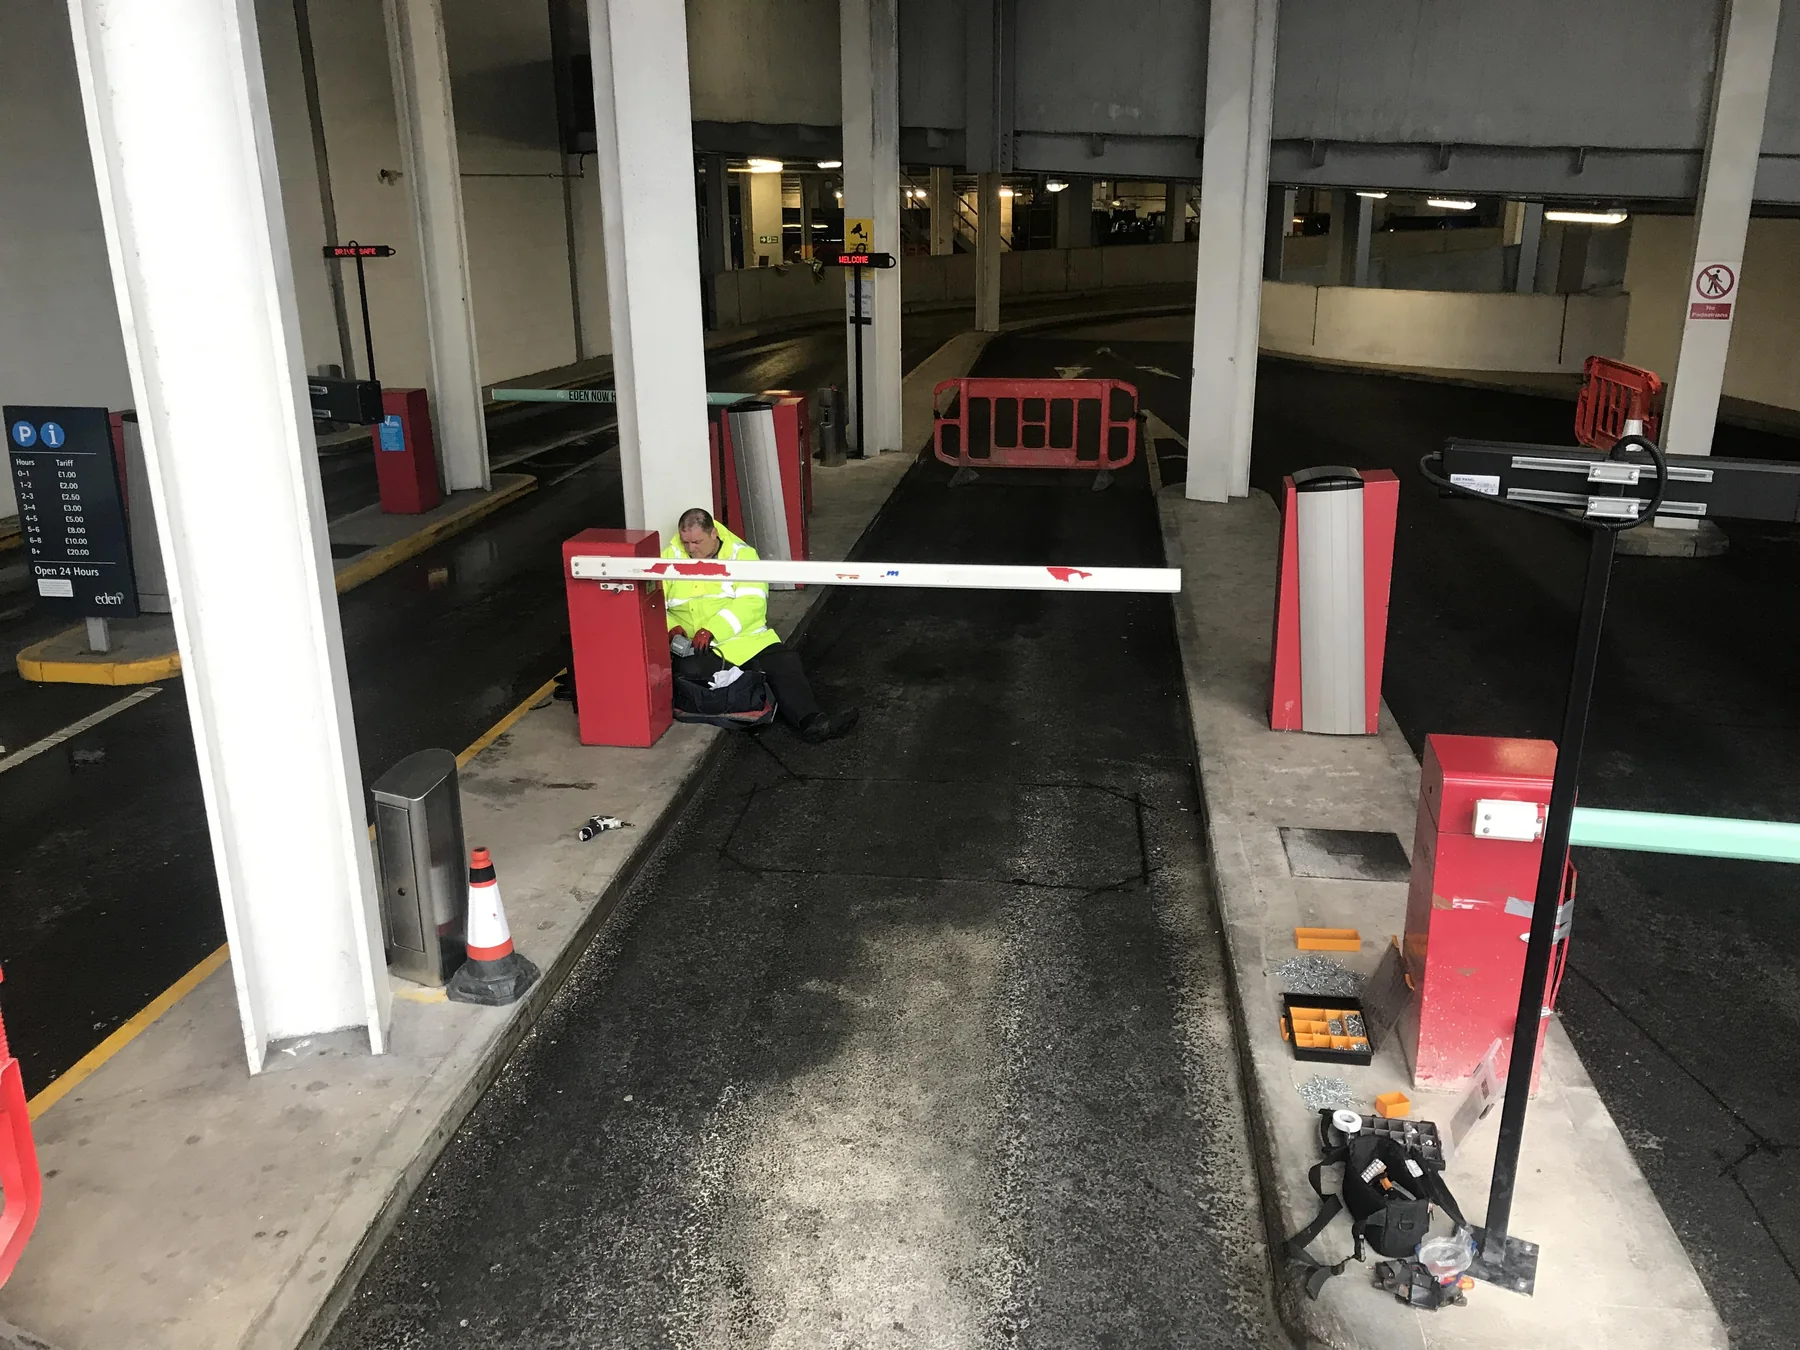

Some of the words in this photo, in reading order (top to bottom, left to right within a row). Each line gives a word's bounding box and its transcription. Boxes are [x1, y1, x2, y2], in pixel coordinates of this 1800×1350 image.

[334, 248, 356, 256] DRIVE
[359, 247, 376, 255] SAFE
[838, 256, 869, 264] WELCOME
[568, 390, 590, 401] EDEN
[591, 391, 609, 402] NOW
[18, 425, 32, 443] P
[16, 458, 35, 466] Hours
[55, 459, 74, 467] Tariff
[20, 481, 32, 489] 1-2
[59, 482, 79, 490] £2.00
[21, 492, 34, 500] 2-3
[23, 503, 36, 511] 3-4
[63, 504, 82, 512] £3.00
[34, 565, 57, 577] Open
[59, 567, 71, 576] 24
[73, 567, 100, 577] Hours
[94, 592, 122, 605] eden
